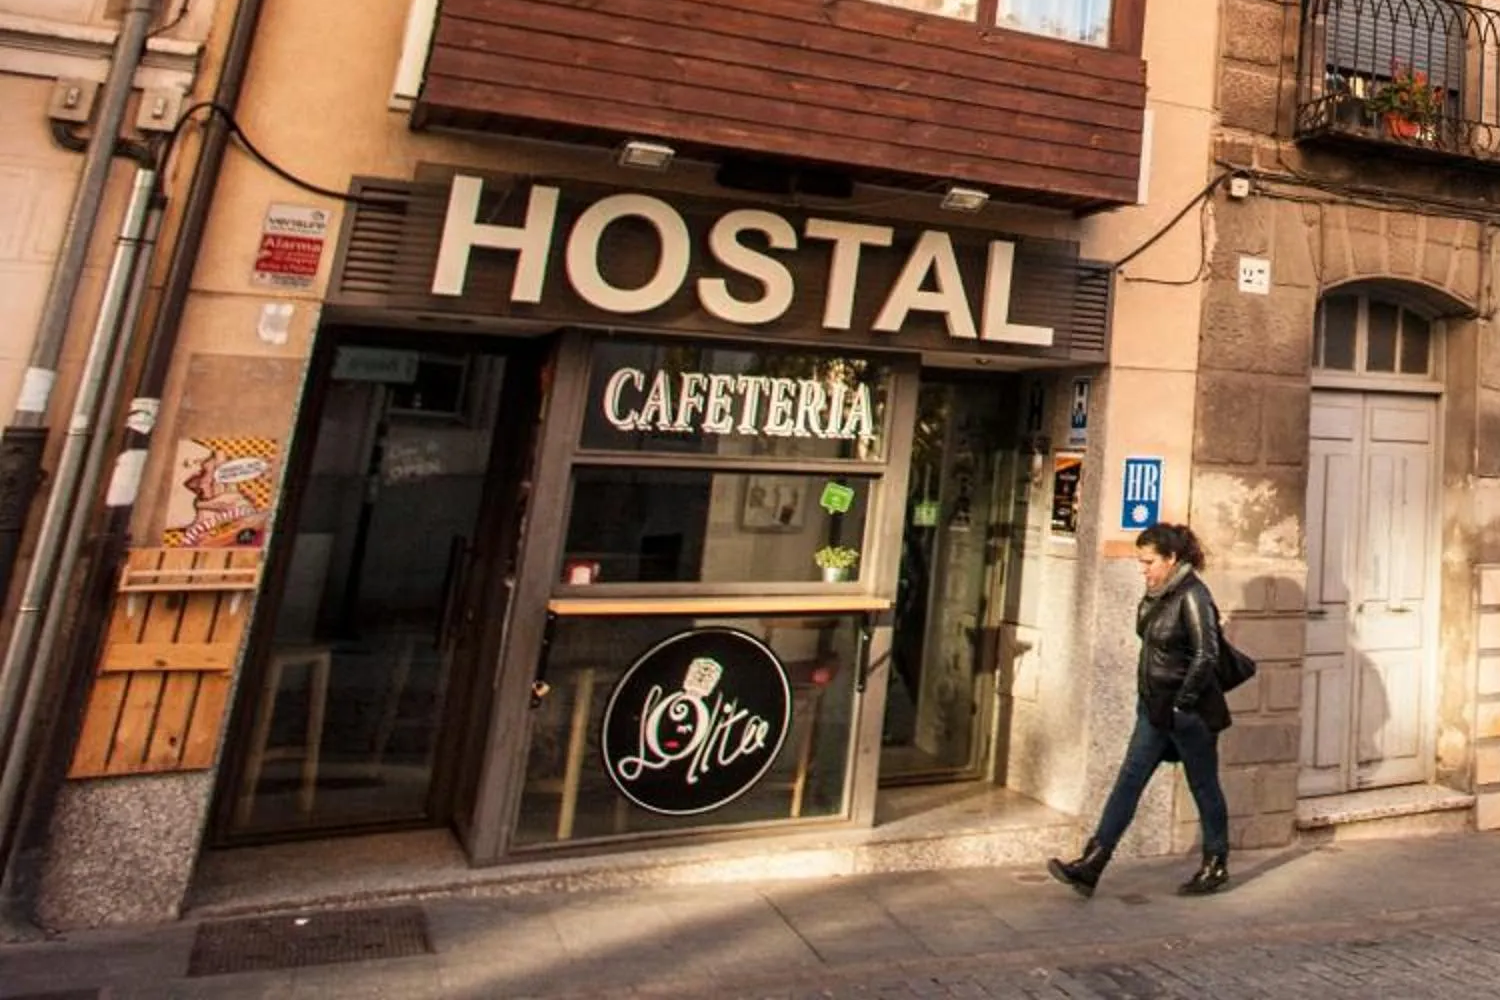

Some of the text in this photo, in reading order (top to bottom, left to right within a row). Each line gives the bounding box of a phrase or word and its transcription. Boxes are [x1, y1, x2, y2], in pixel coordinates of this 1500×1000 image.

[263, 237, 321, 252] Alarma
[432, 174, 1054, 346] HOSTAL
[1127, 463, 1158, 501] HR
